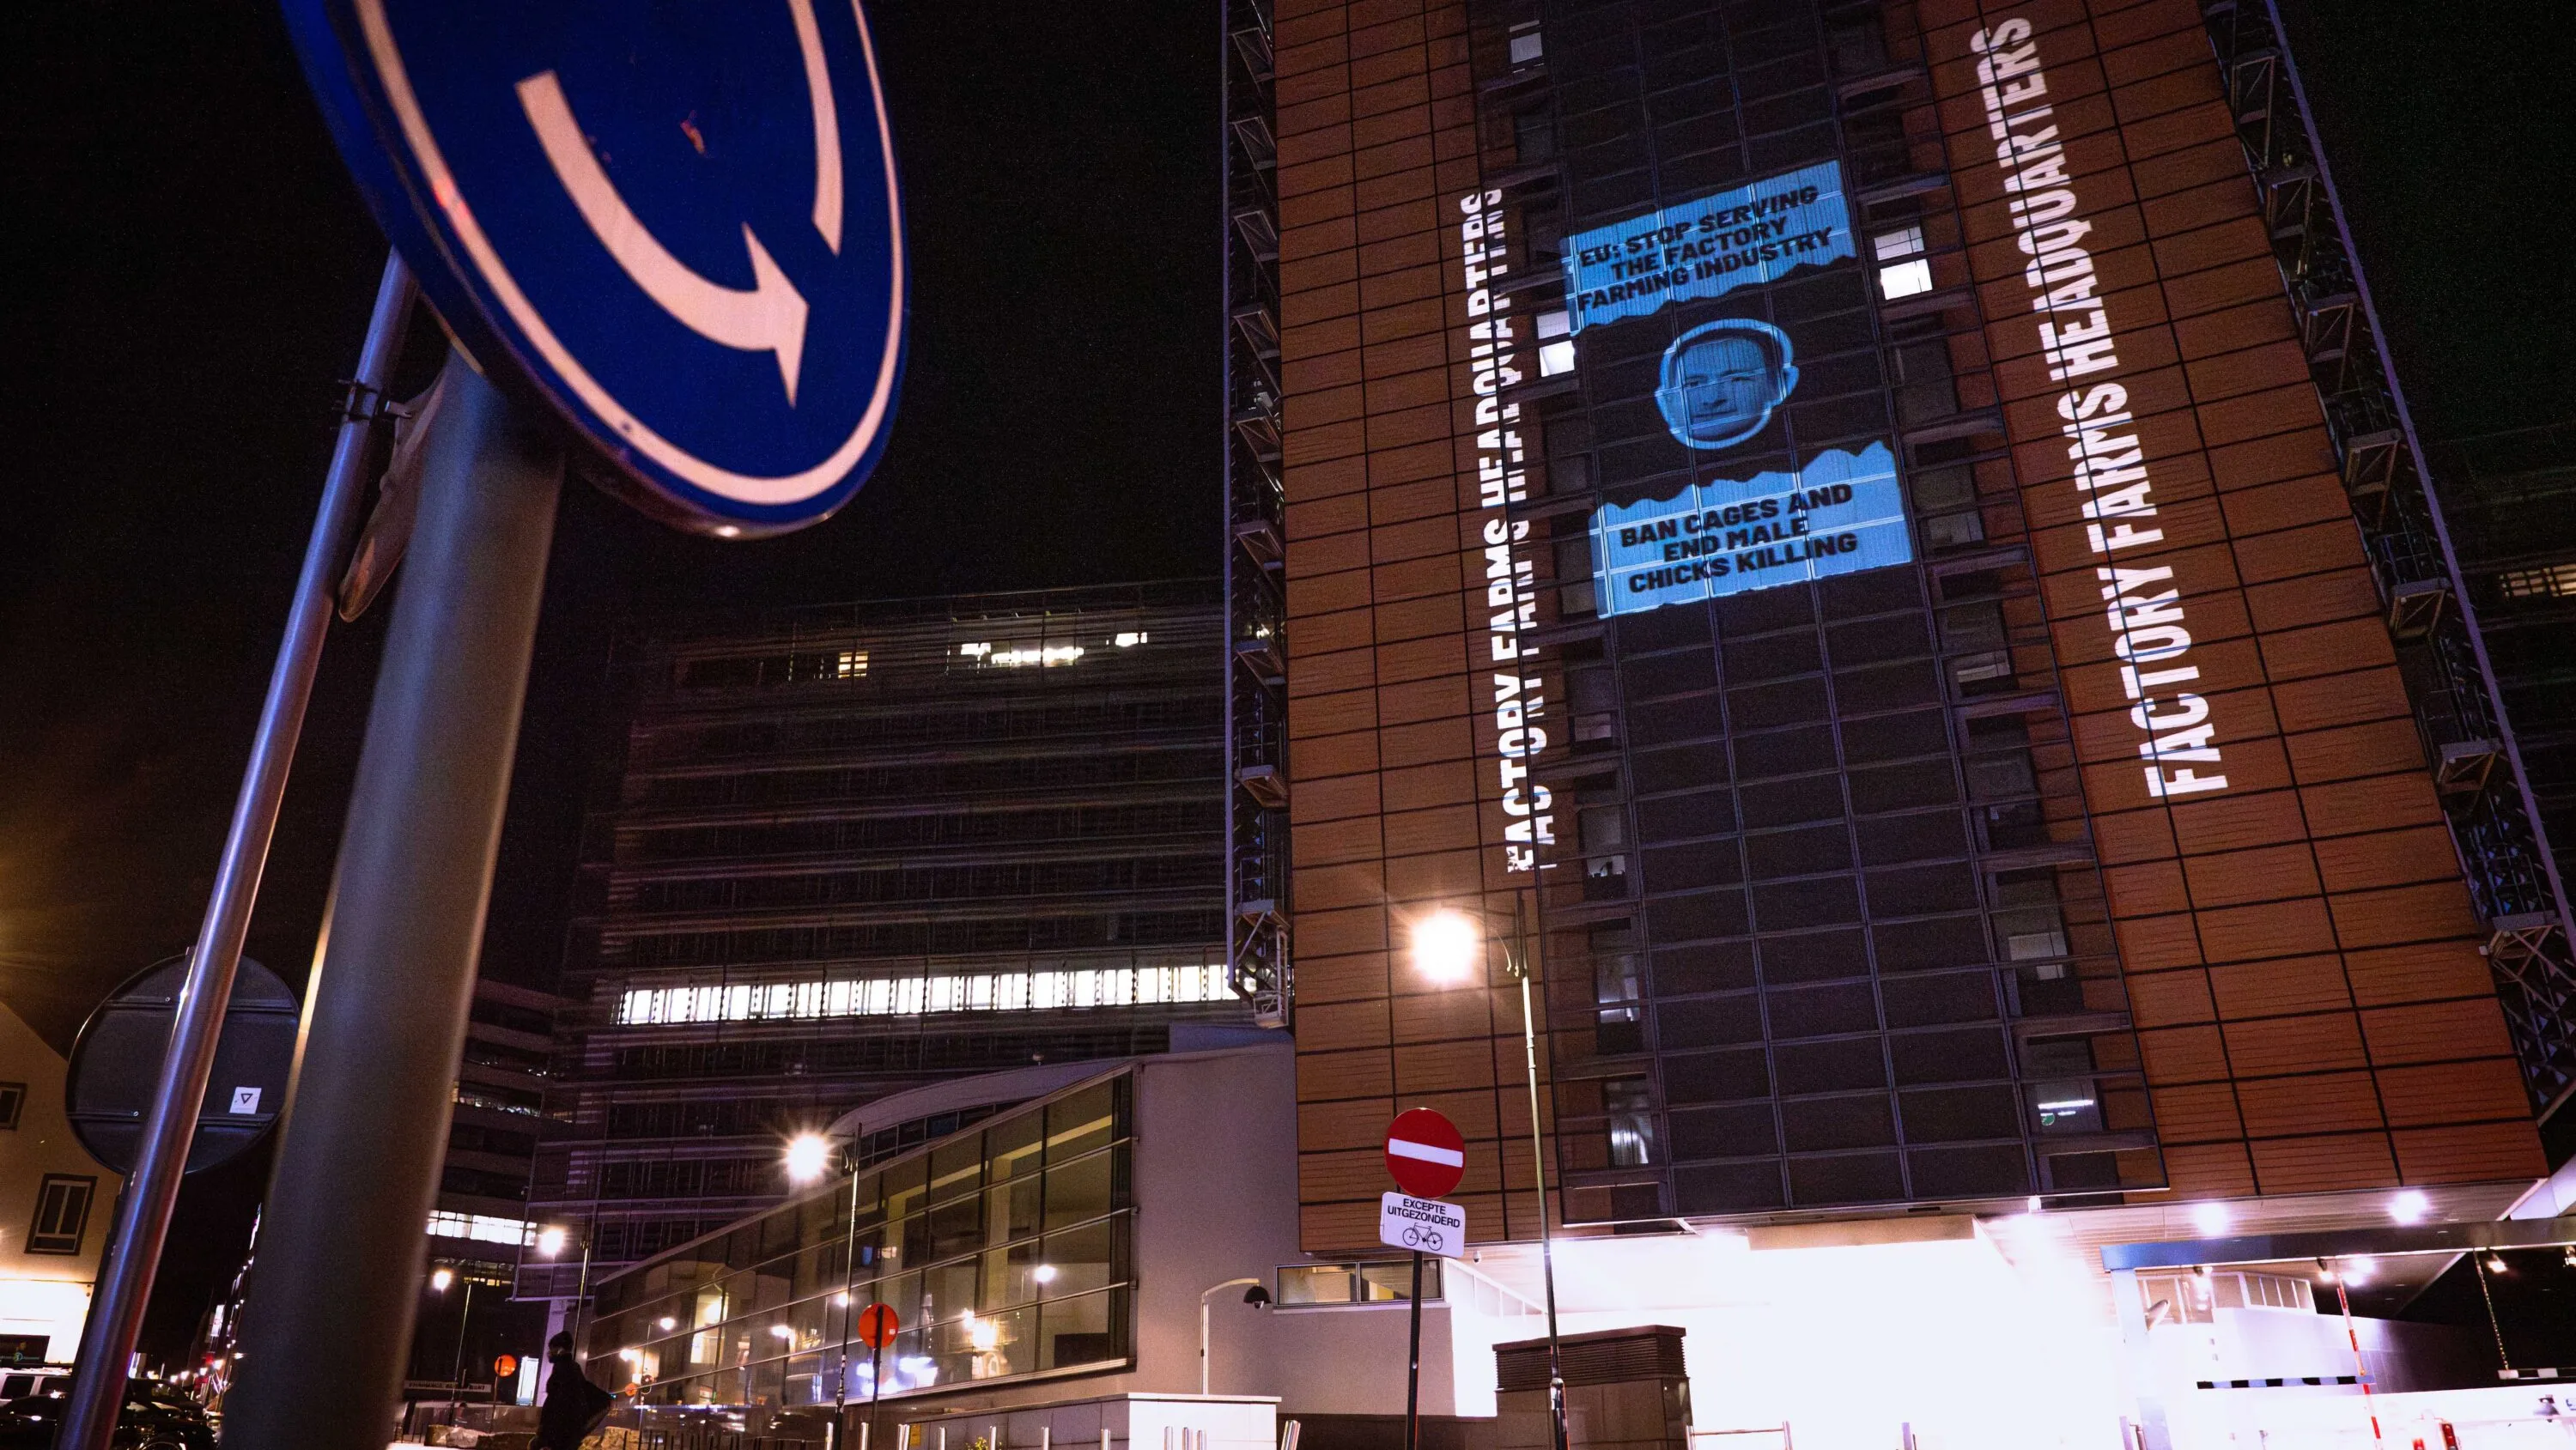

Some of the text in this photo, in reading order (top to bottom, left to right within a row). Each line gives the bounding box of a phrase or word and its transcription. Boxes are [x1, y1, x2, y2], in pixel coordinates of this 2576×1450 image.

[1580, 185, 1820, 267] EU: STOP SERVING
[1611, 215, 1787, 280] THE FACTORY
[1577, 226, 1832, 312] FARMING INDUSTRY
[1970, 17, 2228, 798] FACTORY FARMS HEADQUARTERS
[1620, 483, 1853, 548] BAN CAGES AND
[1663, 517, 1810, 561] END MALE
[1484, 518, 1539, 661] FARMS
[1629, 533, 1858, 593] CHICKS KILLING
[1494, 674, 1557, 872] FACTORY
[1388, 1205, 1461, 1229] UITGEZONDERD
[1403, 1198, 1446, 1215] EXCEPTE
